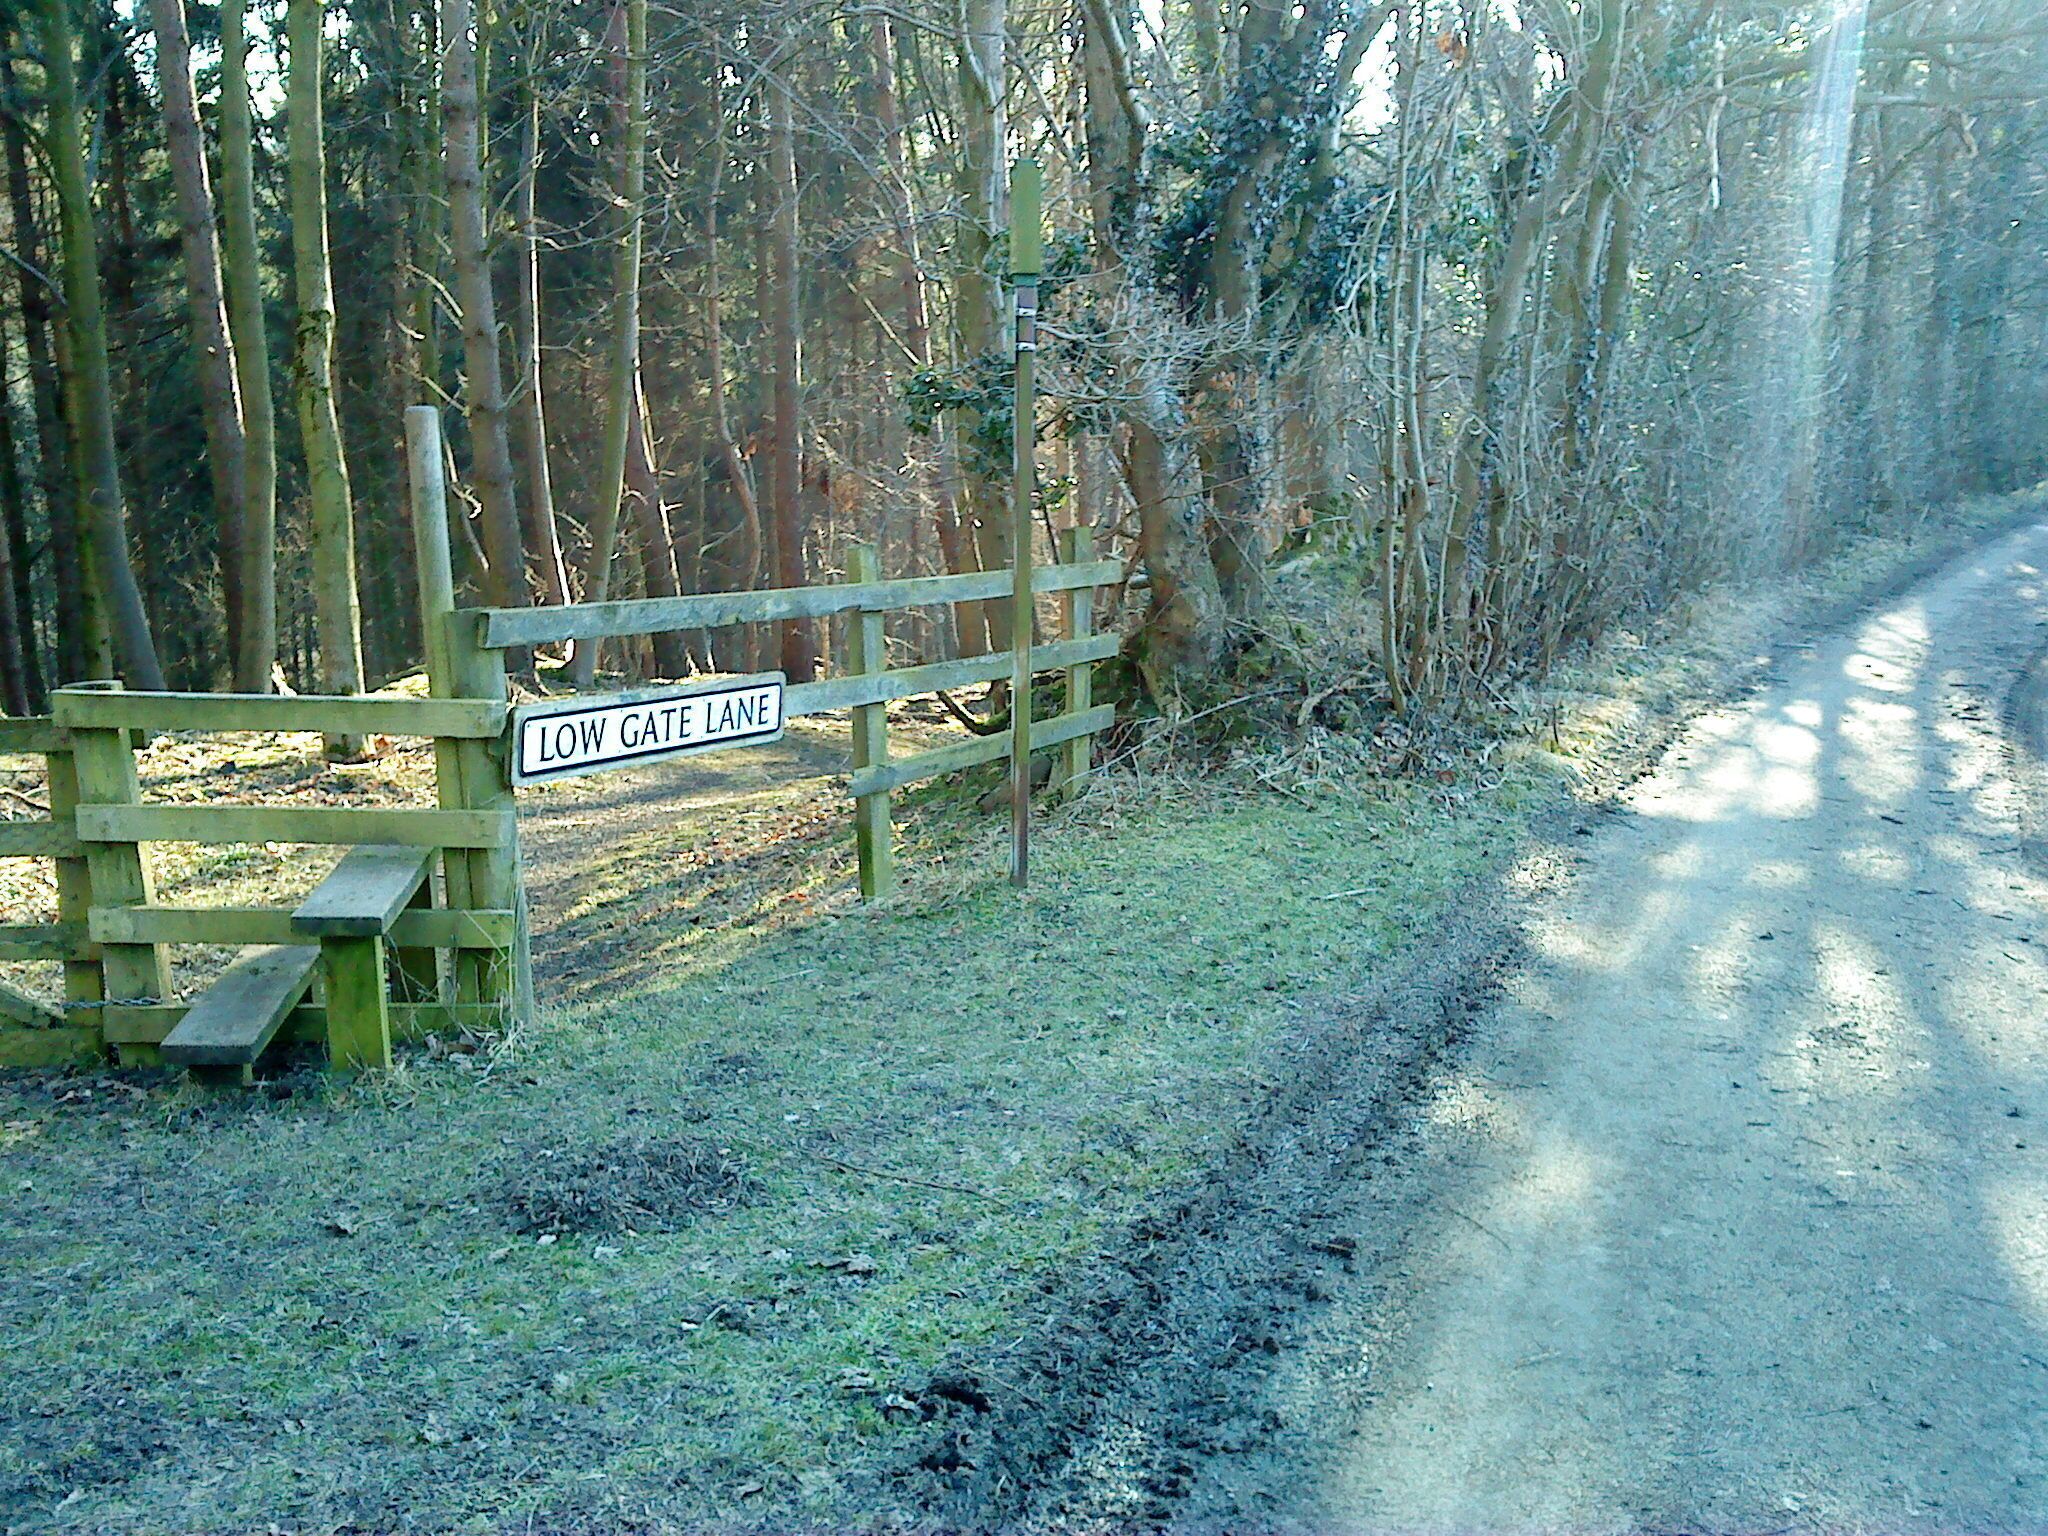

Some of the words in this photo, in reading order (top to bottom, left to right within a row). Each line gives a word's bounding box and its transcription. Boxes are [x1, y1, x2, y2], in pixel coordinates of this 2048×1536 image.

[540, 717, 606, 762] LOW
[620, 706, 691, 748] GATE
[705, 694, 769, 734] LANE
